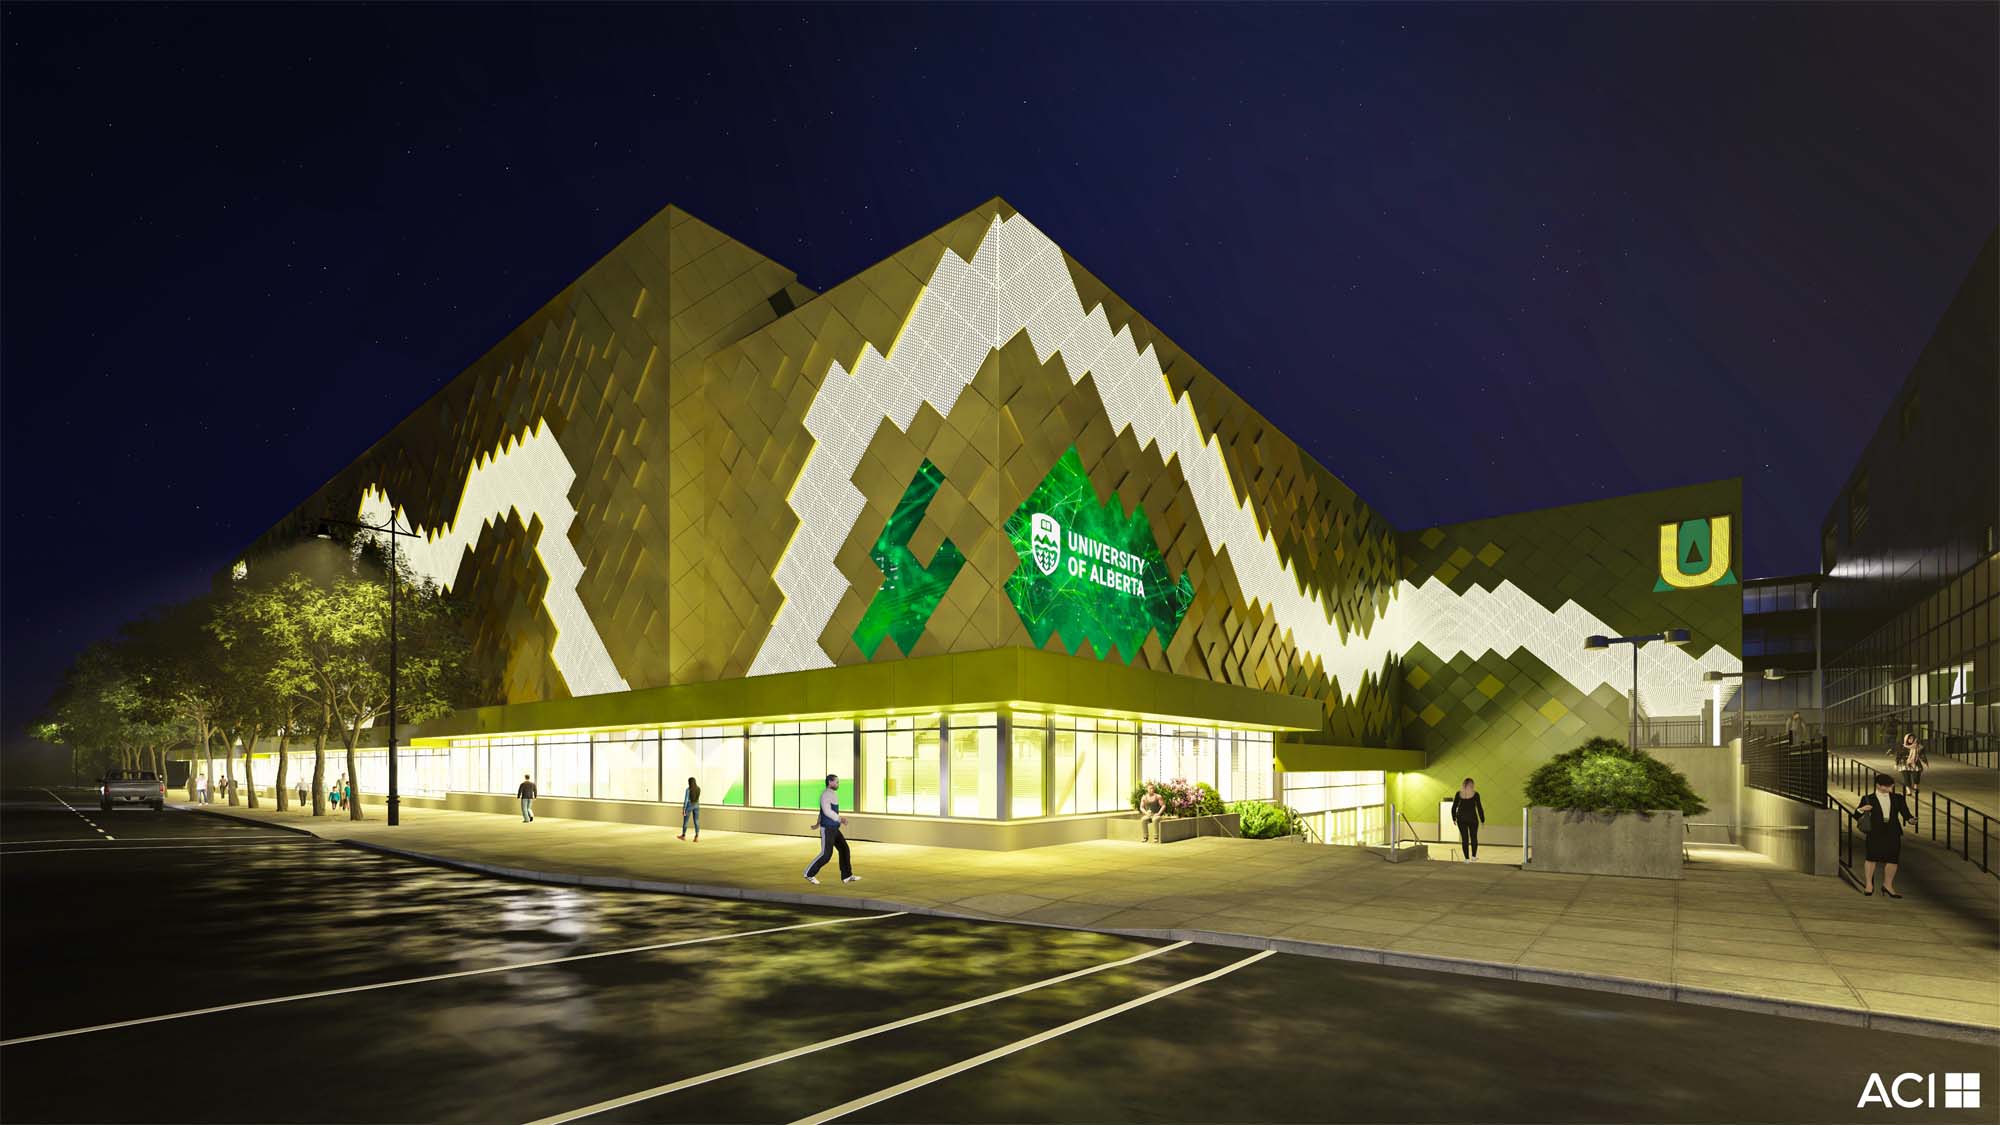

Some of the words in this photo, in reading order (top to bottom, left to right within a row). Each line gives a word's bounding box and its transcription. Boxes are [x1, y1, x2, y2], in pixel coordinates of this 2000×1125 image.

[1068, 530, 1145, 575] UNIVERSITY
[1068, 556, 1087, 579] OF
[1089, 564, 1146, 598] ALBERTA
